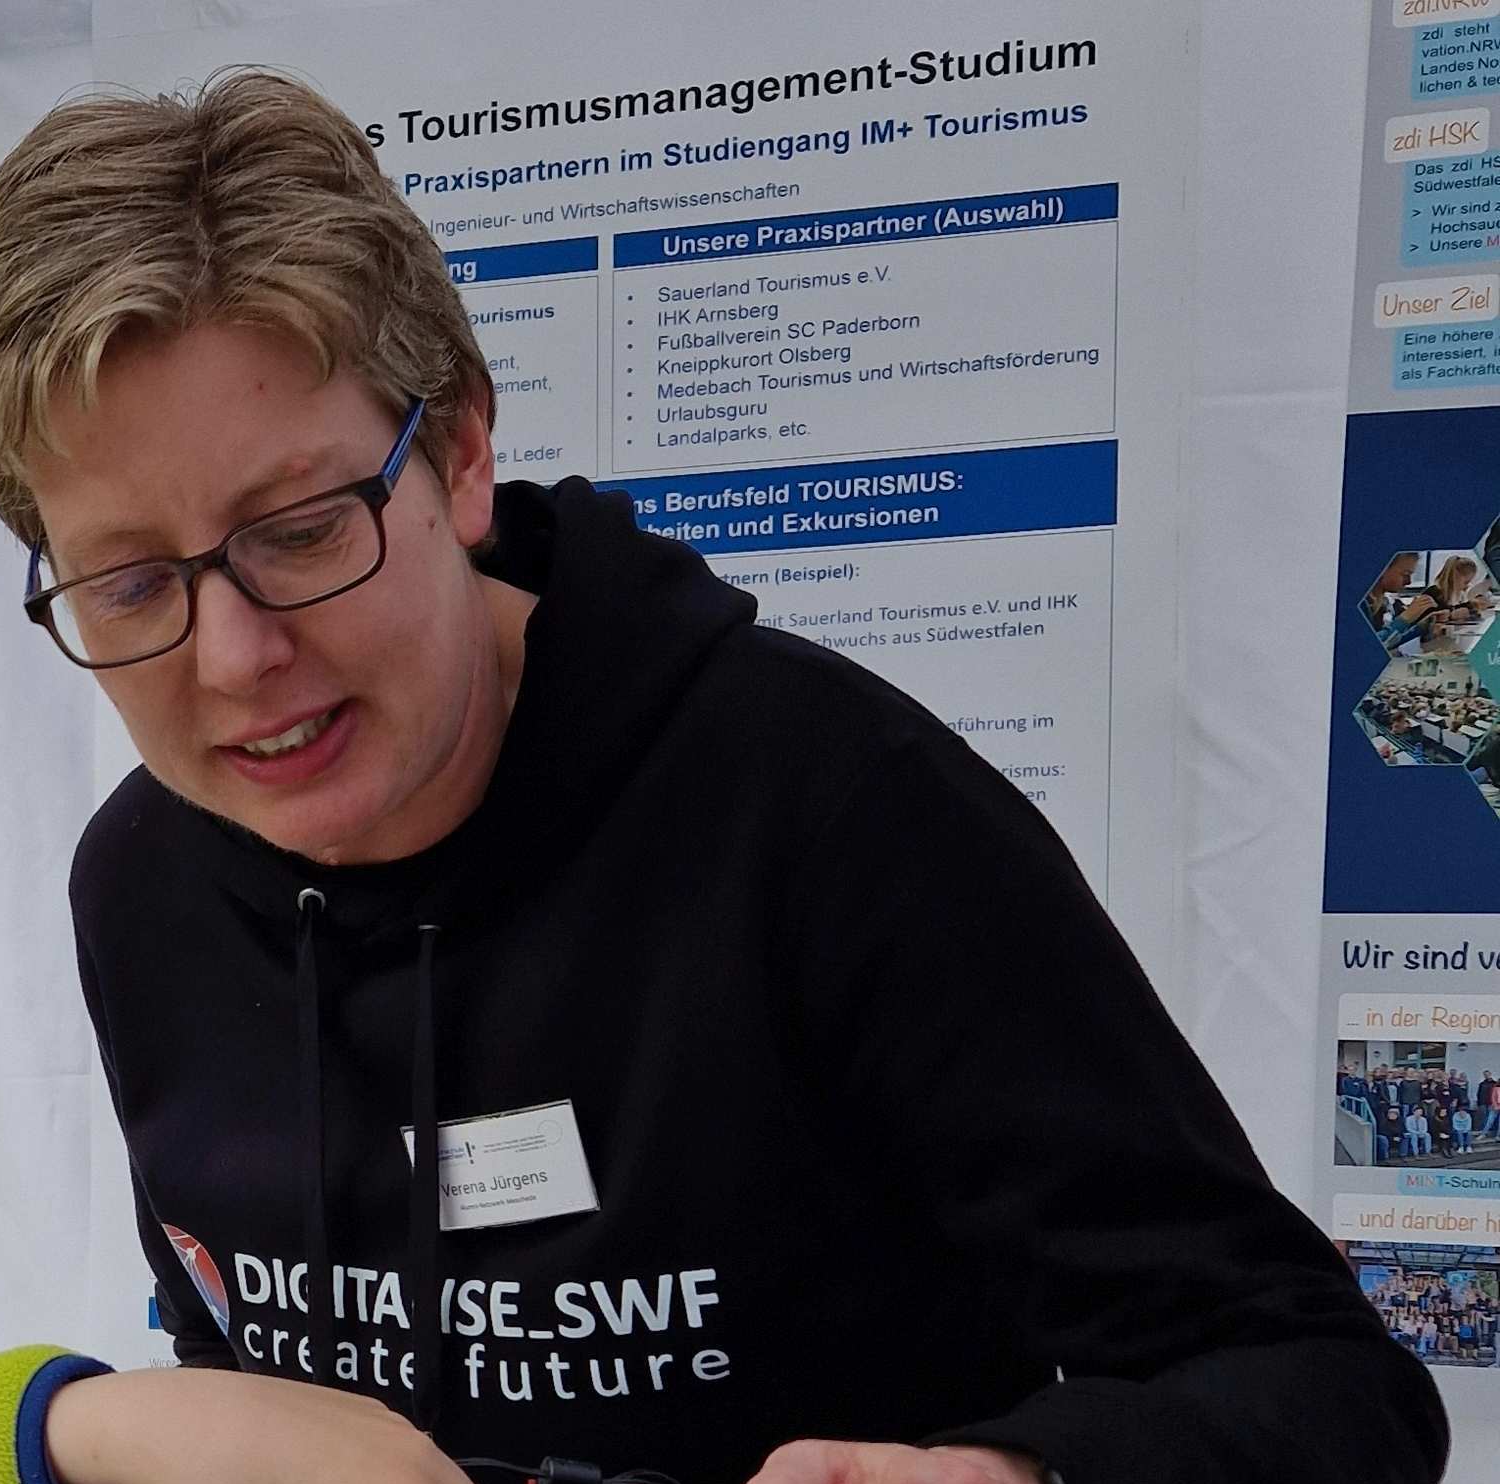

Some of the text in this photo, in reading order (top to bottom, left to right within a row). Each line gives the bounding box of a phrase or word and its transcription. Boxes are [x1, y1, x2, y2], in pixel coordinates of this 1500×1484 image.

[1422, 23, 1491, 41] zdi steht
[1420, 60, 1474, 76] Landes
[398, 39, 1097, 145] Tourismusmanagement-Studium
[1420, 79, 1462, 94] lichen
[1467, 75, 1477, 88] &
[1392, 120, 1481, 152] zdi HSK
[405, 103, 1089, 196] Praxispartnern im Studiengang IM+ Tourismus
[1414, 163, 1444, 177] Das
[1451, 158, 1473, 172] zdi
[1413, 175, 1500, 194] Südwestfale
[430, 181, 801, 238] Ingenieur- und Wirtschaftswissenschaften
[1431, 203, 1457, 217] Wir
[1460, 200, 1491, 215] sind
[663, 196, 1064, 257] Unsere Praxispartner (Auswahl)
[1430, 219, 1500, 235] Hochsau
[1429, 238, 1483, 252] Unsere
[657, 265, 892, 303] Sauerland Tourismus e.V.
[1383, 286, 1491, 317] Unser Ziel
[468, 305, 556, 326] ourismus
[658, 303, 779, 327] IHK Arnsberg
[657, 313, 921, 351] Fußballverein SC Paderborn
[1403, 333, 1437, 346] Eine
[657, 345, 852, 376] Kneippkurort Olsberg
[657, 347, 1100, 400] Medebach Tourismus und Wirtschaftsförderung
[1401, 368, 1423, 381] als
[657, 401, 768, 424] Urlaubsguru
[657, 421, 811, 447] Landalparks, etc.
[513, 446, 564, 463] Leder
[665, 484, 790, 513] Berufsfeld
[798, 470, 964, 502] TOURISMUS:
[728, 515, 774, 538] und
[783, 504, 940, 534] Exkursionen
[774, 563, 861, 587] (Beispiel):
[789, 606, 873, 628] Sauerland
[879, 602, 967, 623] Tourismus
[972, 600, 1001, 616] e.V.
[1007, 595, 1042, 614] und
[1047, 593, 1078, 610] IHK
[892, 632, 921, 646] aus
[926, 620, 1045, 643] Südwestfalen
[1032, 714, 1054, 729] im
[1343, 939, 1395, 969] Wir
[1404, 941, 1469, 971] sind
[1366, 1007, 1384, 1027] in
[1391, 1006, 1423, 1027] der
[441, 1170, 548, 1198] Verena Jürgens
[1359, 1208, 1396, 1228] und
[1401, 1208, 1478, 1232] darüber
[233, 1252, 717, 1340] DIGITAISE_SWF
[243, 1322, 731, 1401] create future
